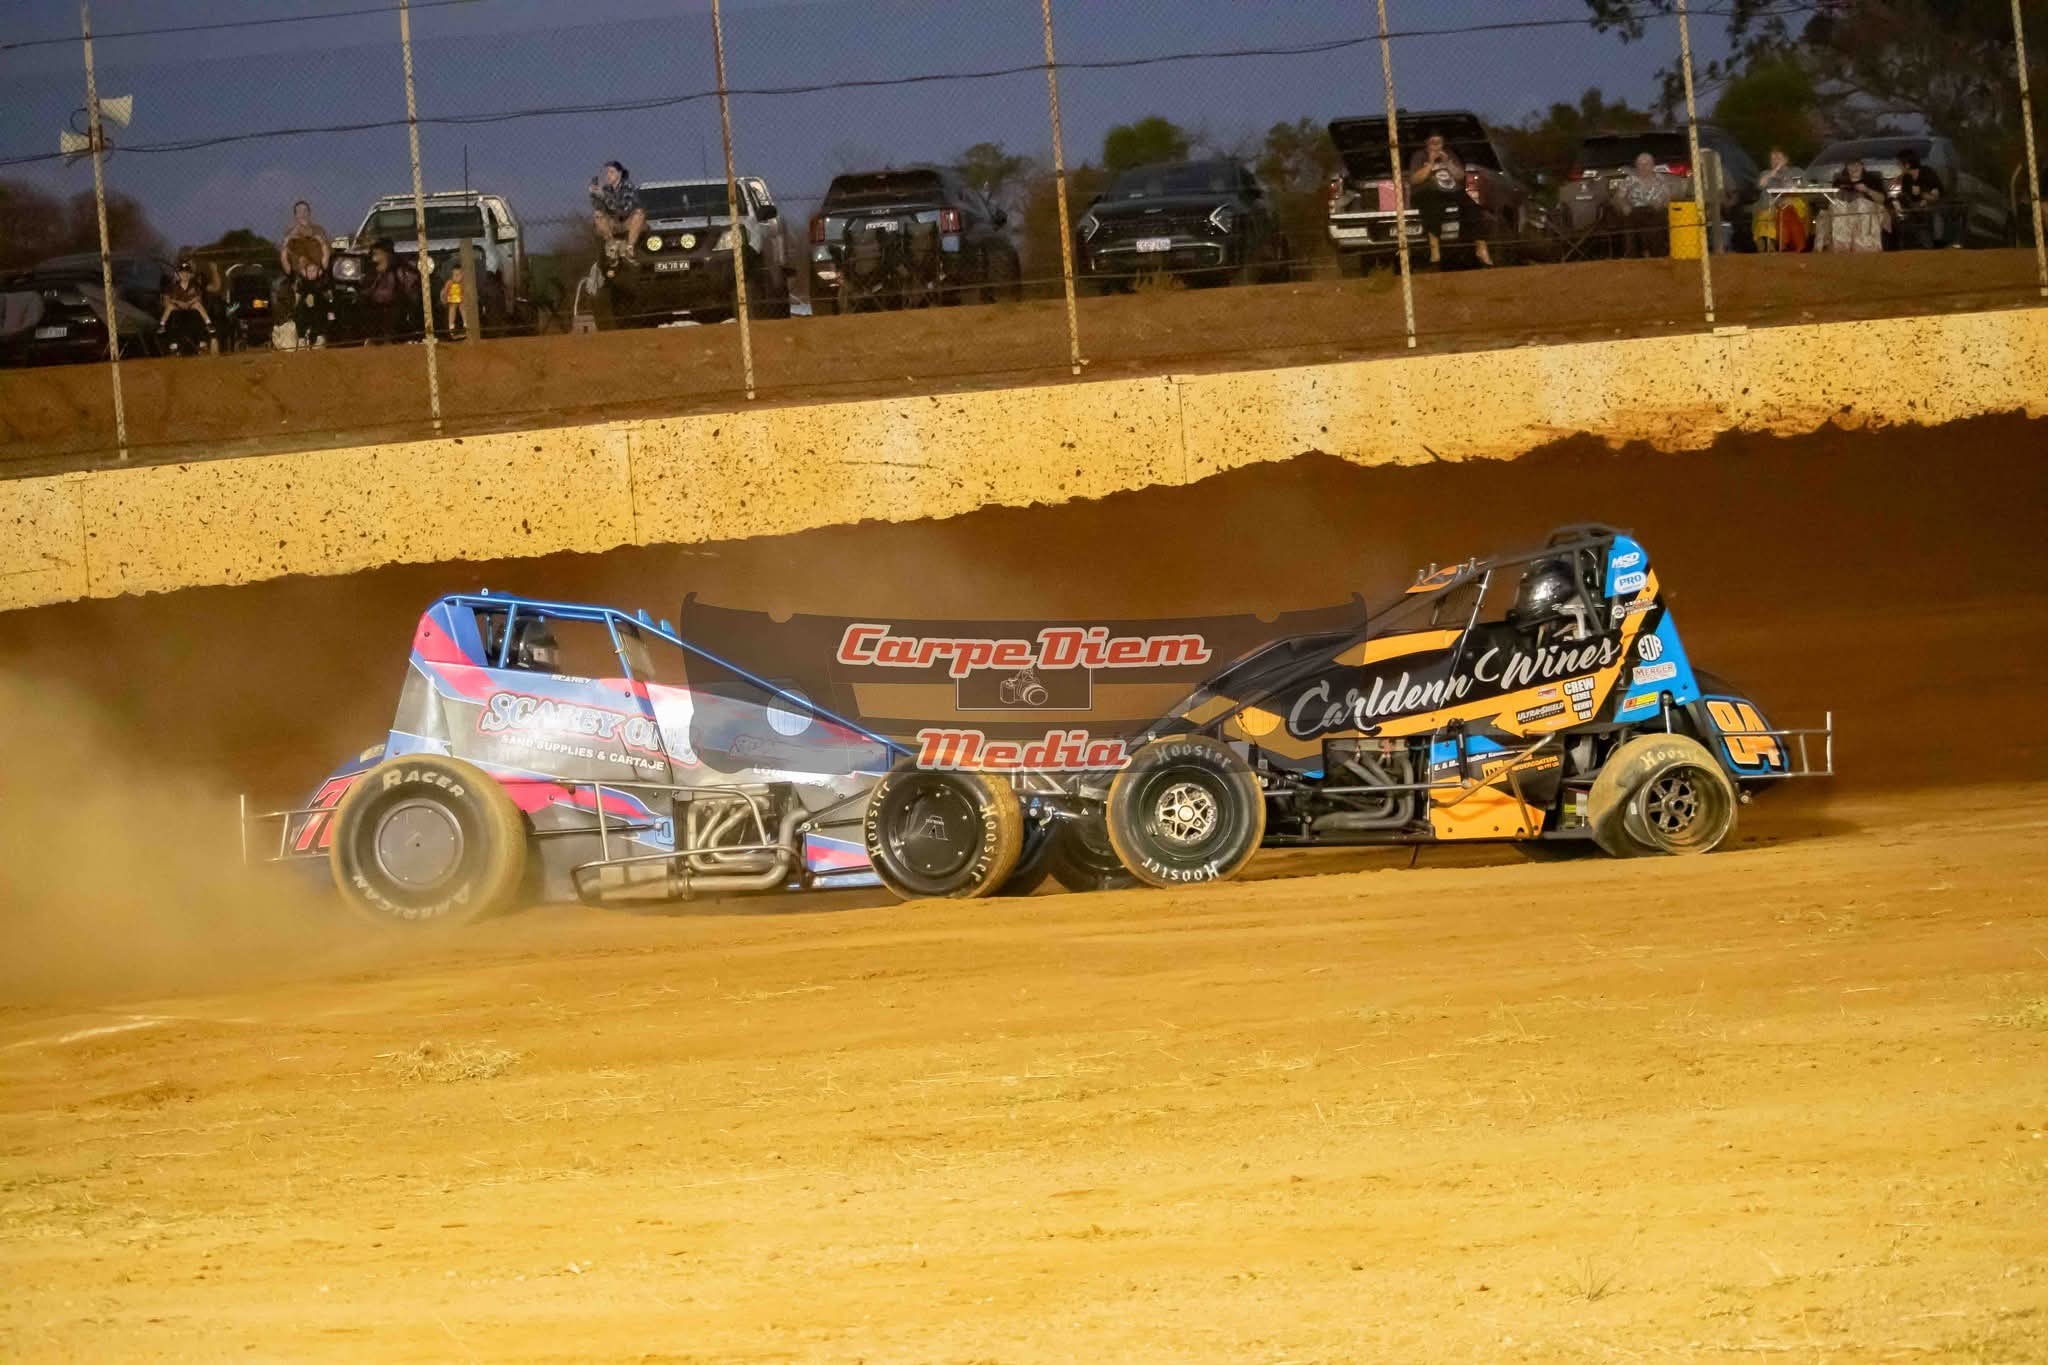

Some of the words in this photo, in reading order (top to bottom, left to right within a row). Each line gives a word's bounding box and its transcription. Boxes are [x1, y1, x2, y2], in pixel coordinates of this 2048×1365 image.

[1619, 574, 1642, 587] PRO
[1288, 671, 1475, 737] Carldenn
[1474, 637, 1621, 690] Wines
[1564, 677, 1595, 695] CREW
[501, 734, 534, 747] SAND
[536, 740, 593, 758] SUPPLIES
[597, 751, 606, 761] &
[1156, 744, 1232, 768] Hoosier
[383, 768, 465, 799] RACER
[971, 803, 998, 883] Hoosier
[1141, 857, 1222, 883] Hoosier
